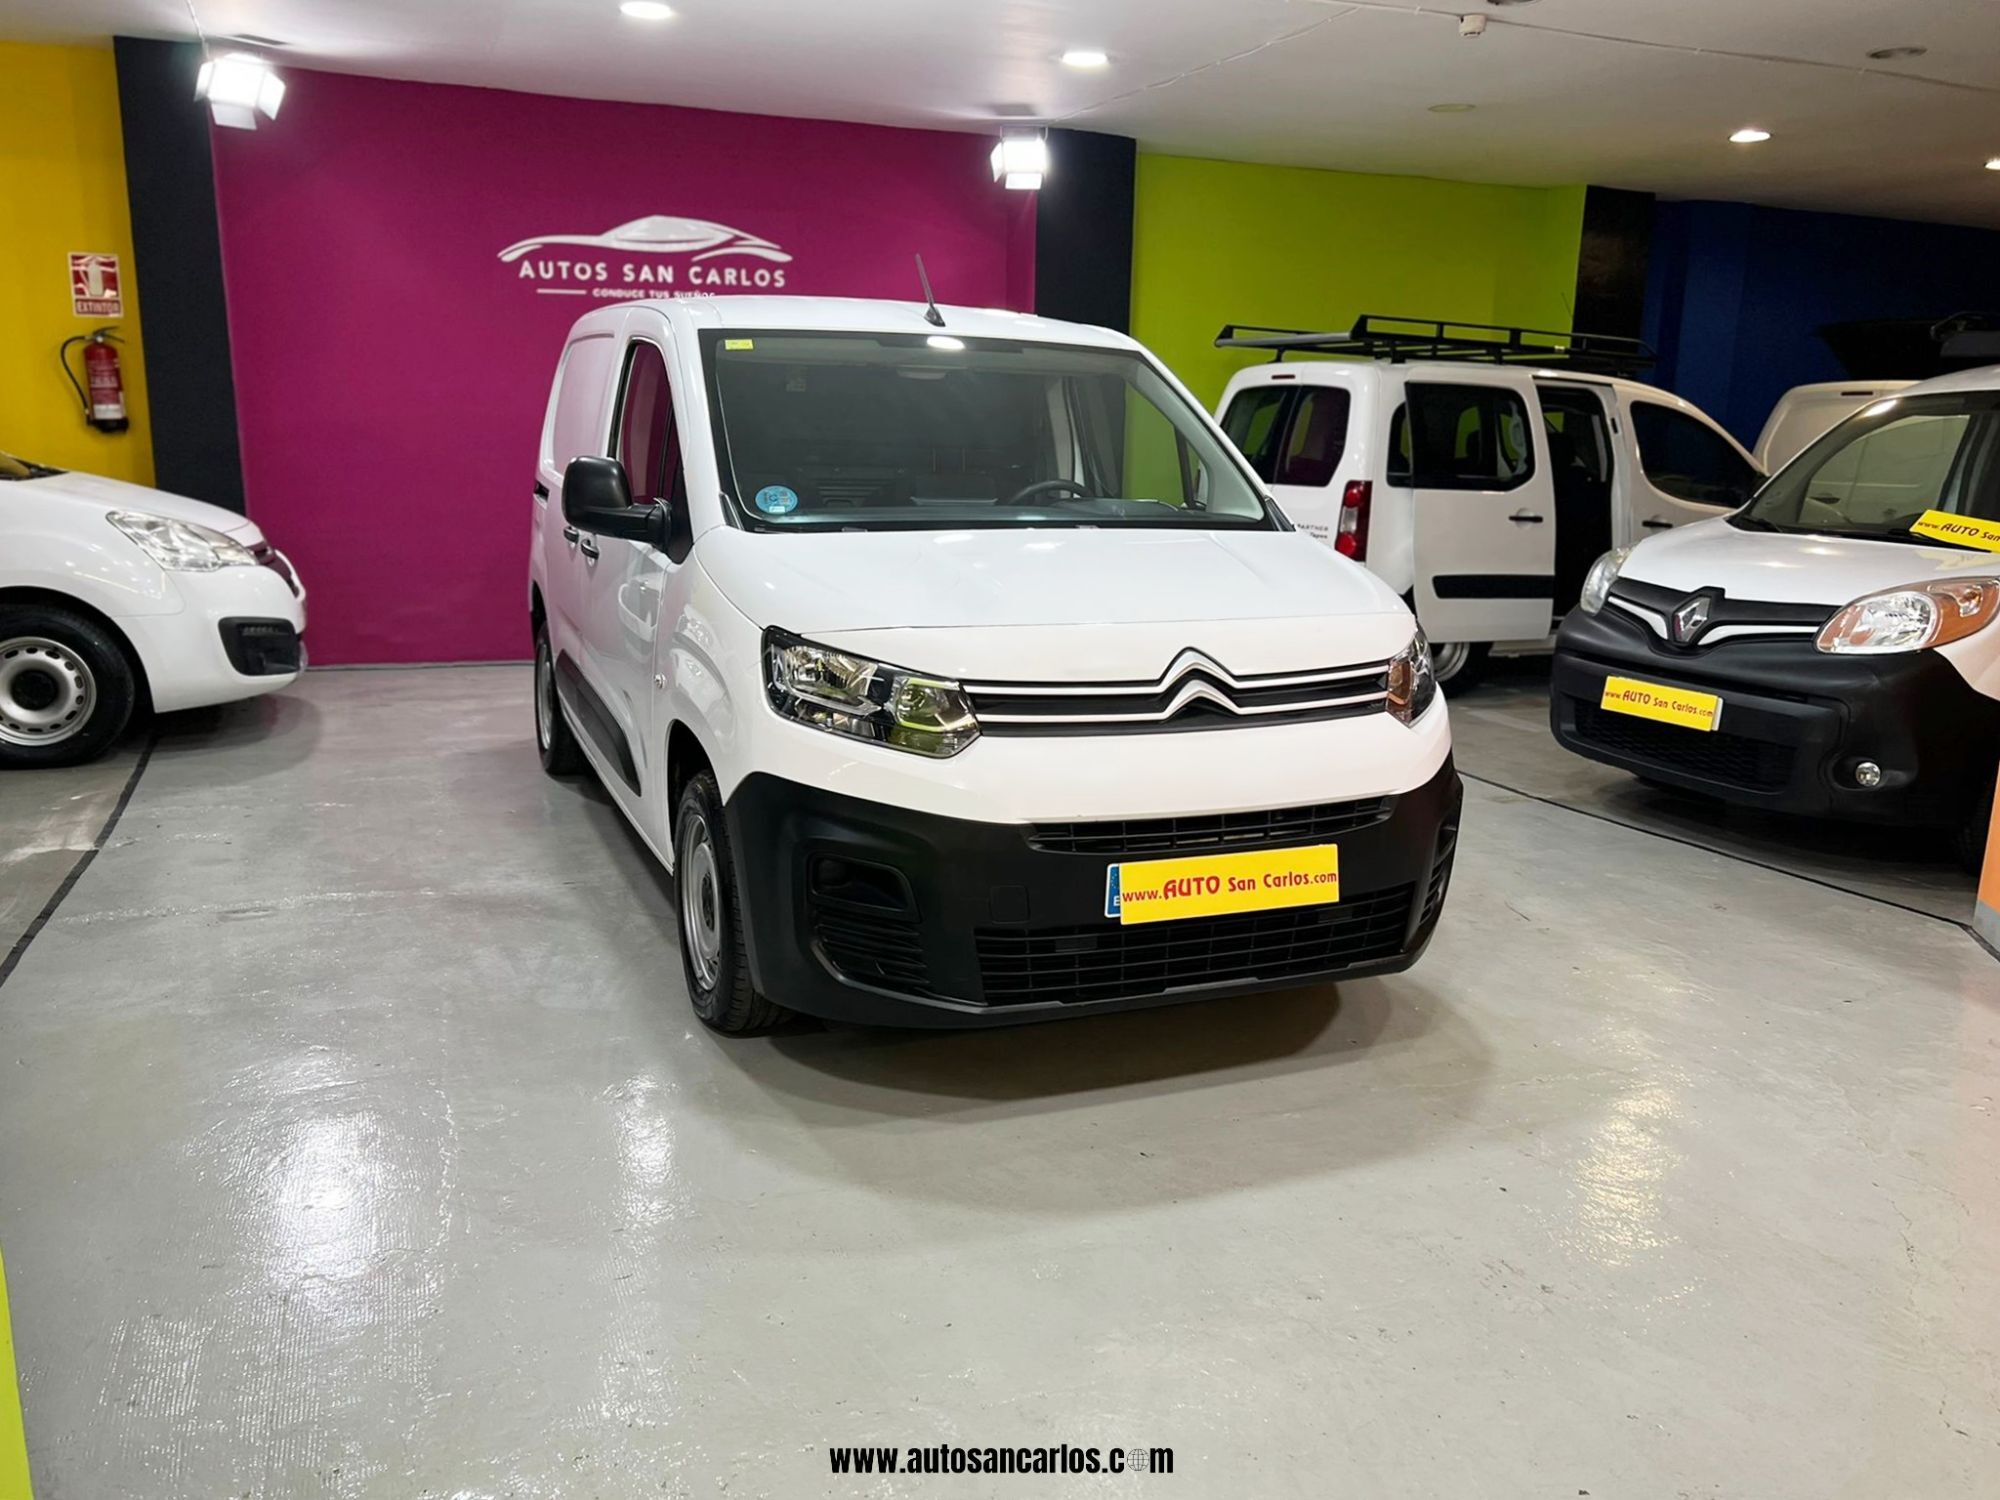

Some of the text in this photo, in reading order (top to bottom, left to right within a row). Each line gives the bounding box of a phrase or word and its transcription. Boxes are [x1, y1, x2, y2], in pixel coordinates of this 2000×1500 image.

[518, 260, 786, 288] AUTOS SAN CARLOS
[592, 288, 645, 299] CONDUCE
[648, 289, 670, 299] TUS
[76, 300, 120, 313] EXTINTOR
[1653, 697, 1669, 708] San
[1228, 876, 1256, 893] San
[1263, 871, 1337, 889] Carlos.com
[1113, 895, 1120, 907] E
